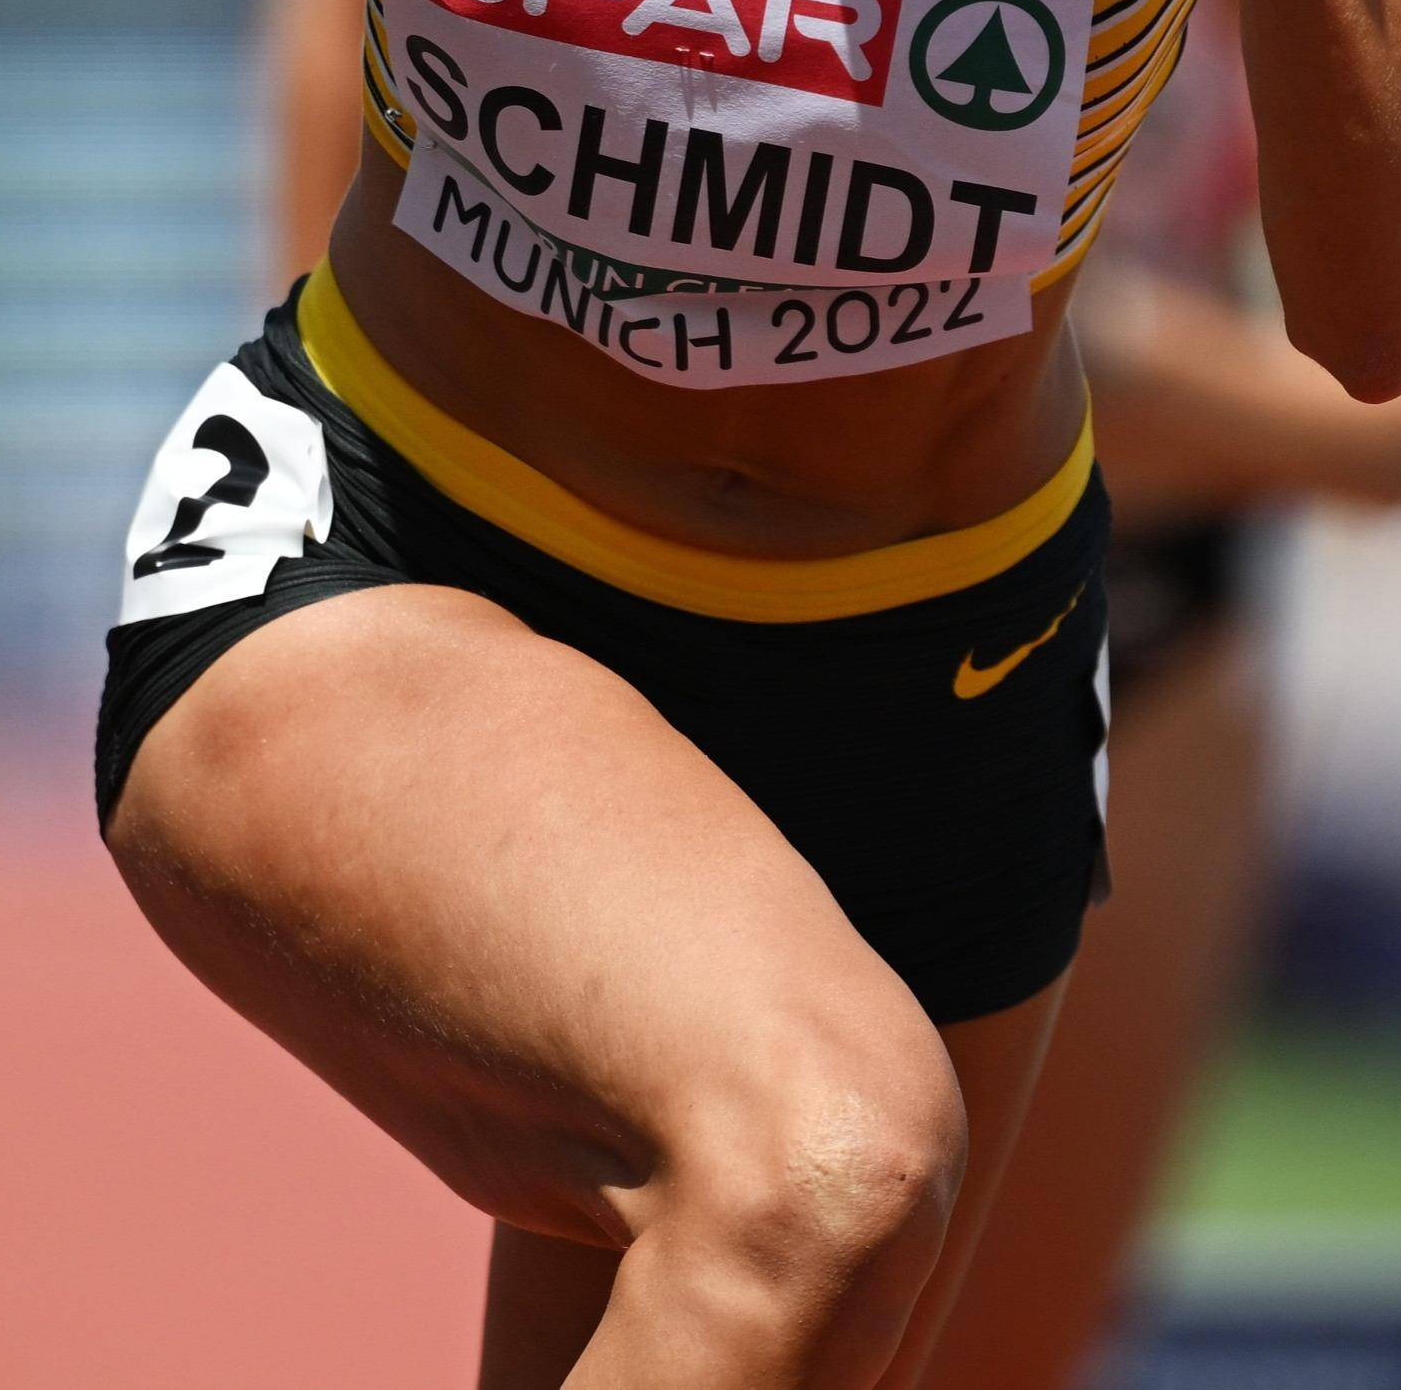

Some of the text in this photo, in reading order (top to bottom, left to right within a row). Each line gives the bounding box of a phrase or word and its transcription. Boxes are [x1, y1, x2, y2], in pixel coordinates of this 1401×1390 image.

[405, 34, 1037, 276] SCHMIDT
[433, 175, 984, 372] MUNICH 2022
[133, 414, 269, 580] 2
